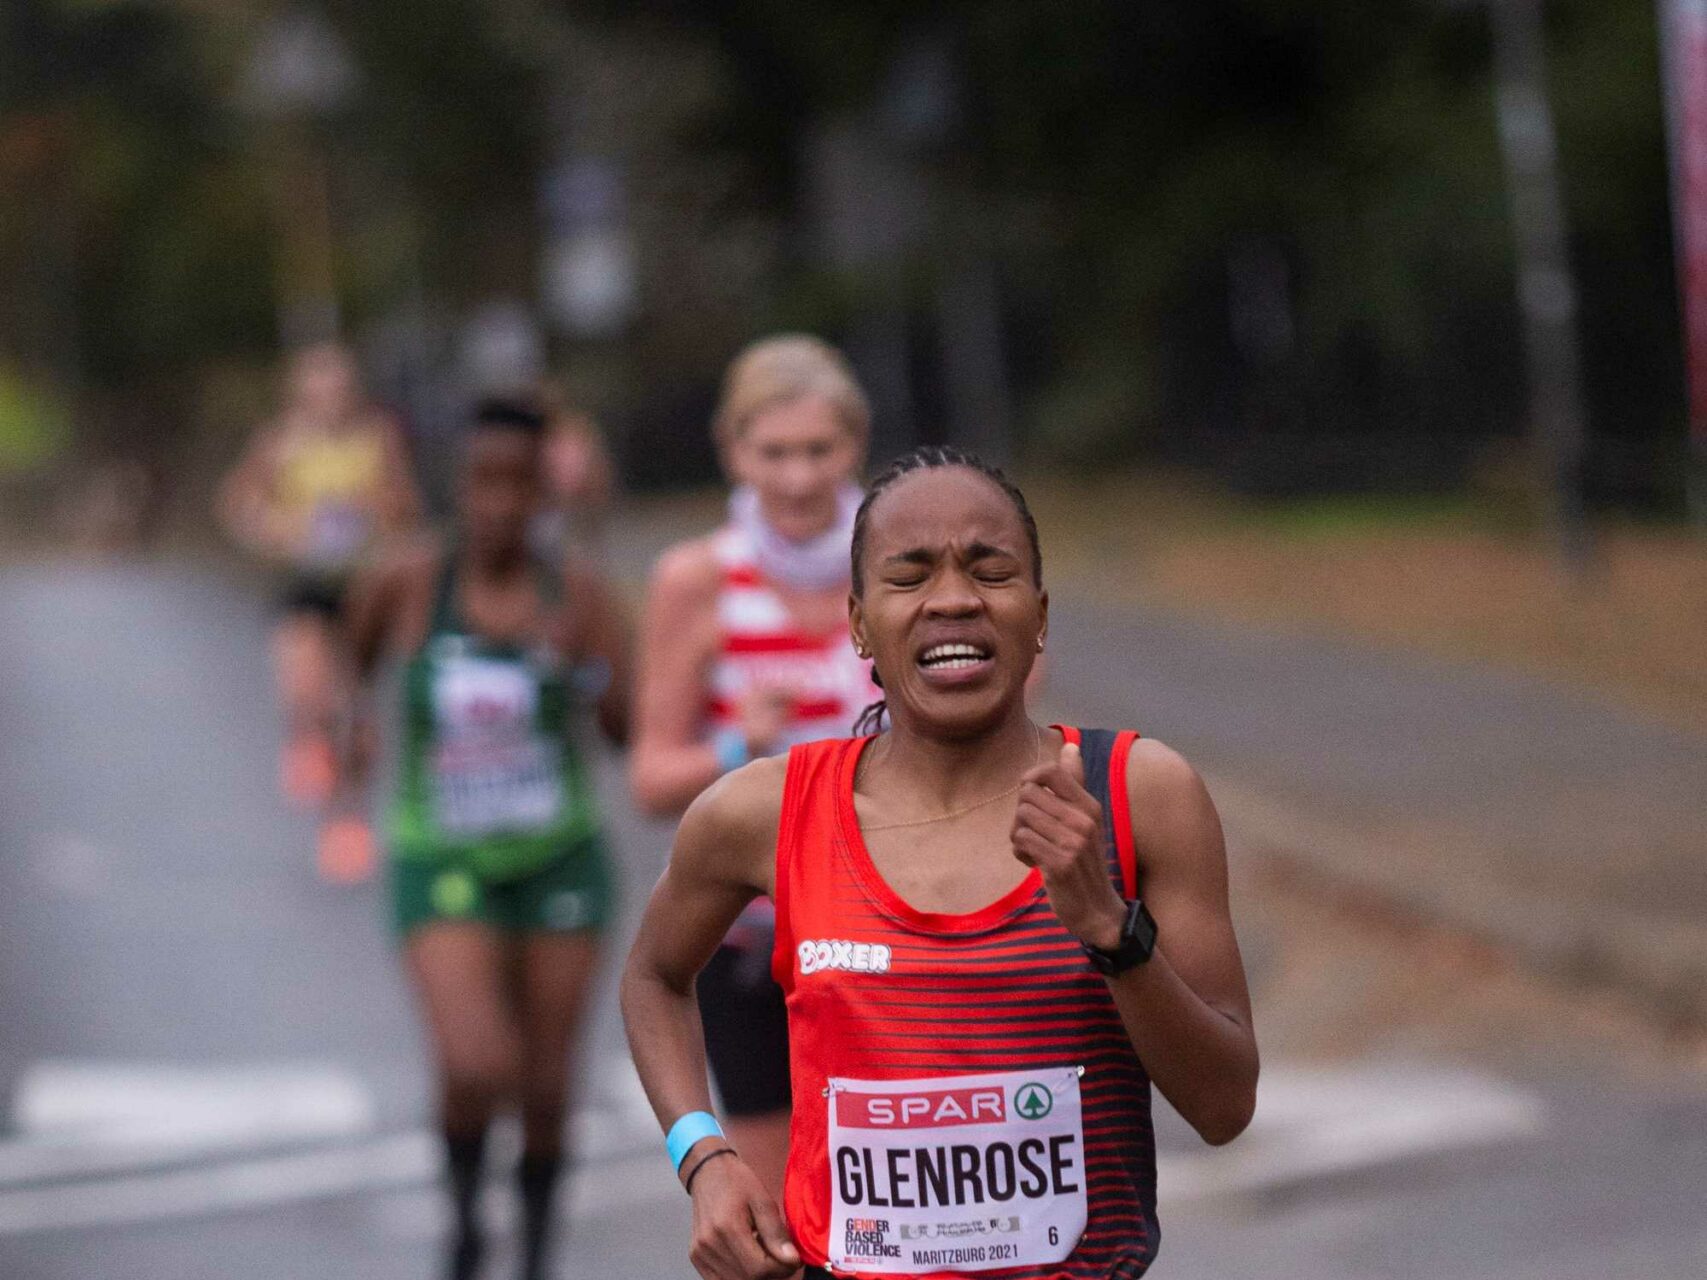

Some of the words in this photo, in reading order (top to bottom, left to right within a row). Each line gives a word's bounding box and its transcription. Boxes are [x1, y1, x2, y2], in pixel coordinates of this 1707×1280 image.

[798, 940, 891, 975] BOXER
[868, 1093, 1003, 1124] SPAR
[836, 1134, 1078, 1208] GLENROSE
[846, 1218, 889, 1232] GENDER
[845, 1231, 884, 1243] BASED
[1048, 1226, 1059, 1246] 6
[845, 1242, 902, 1257] VIOLENCE
[912, 1247, 986, 1265] MARITZBURG
[989, 1244, 1019, 1260] 2021
